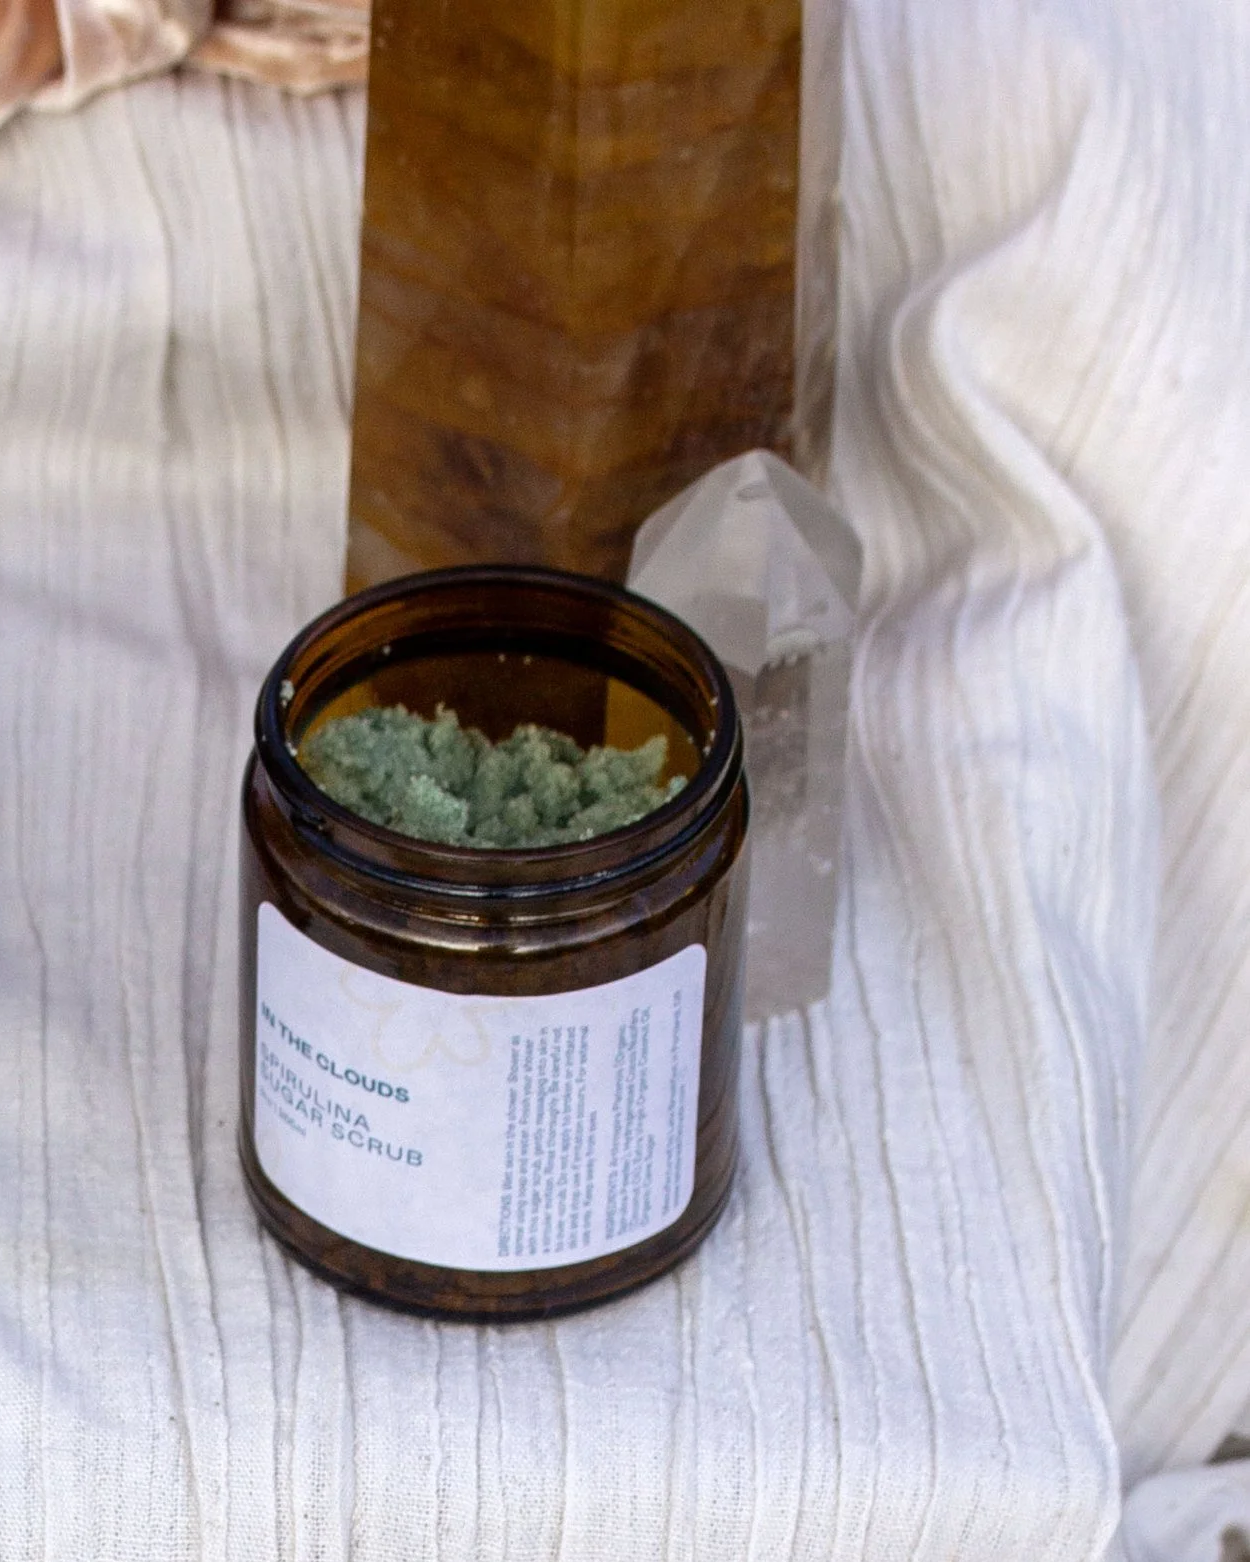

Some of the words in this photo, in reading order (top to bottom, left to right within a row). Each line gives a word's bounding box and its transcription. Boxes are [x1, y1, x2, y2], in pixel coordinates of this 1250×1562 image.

[260, 1041, 370, 1131] SPIRULINA
[261, 1001, 276, 1029] IN
[277, 1020, 313, 1060] THE
[316, 1054, 410, 1104] CLOUDS
[260, 1065, 323, 1129] SUGAR
[332, 1122, 424, 1167] SCRUB
